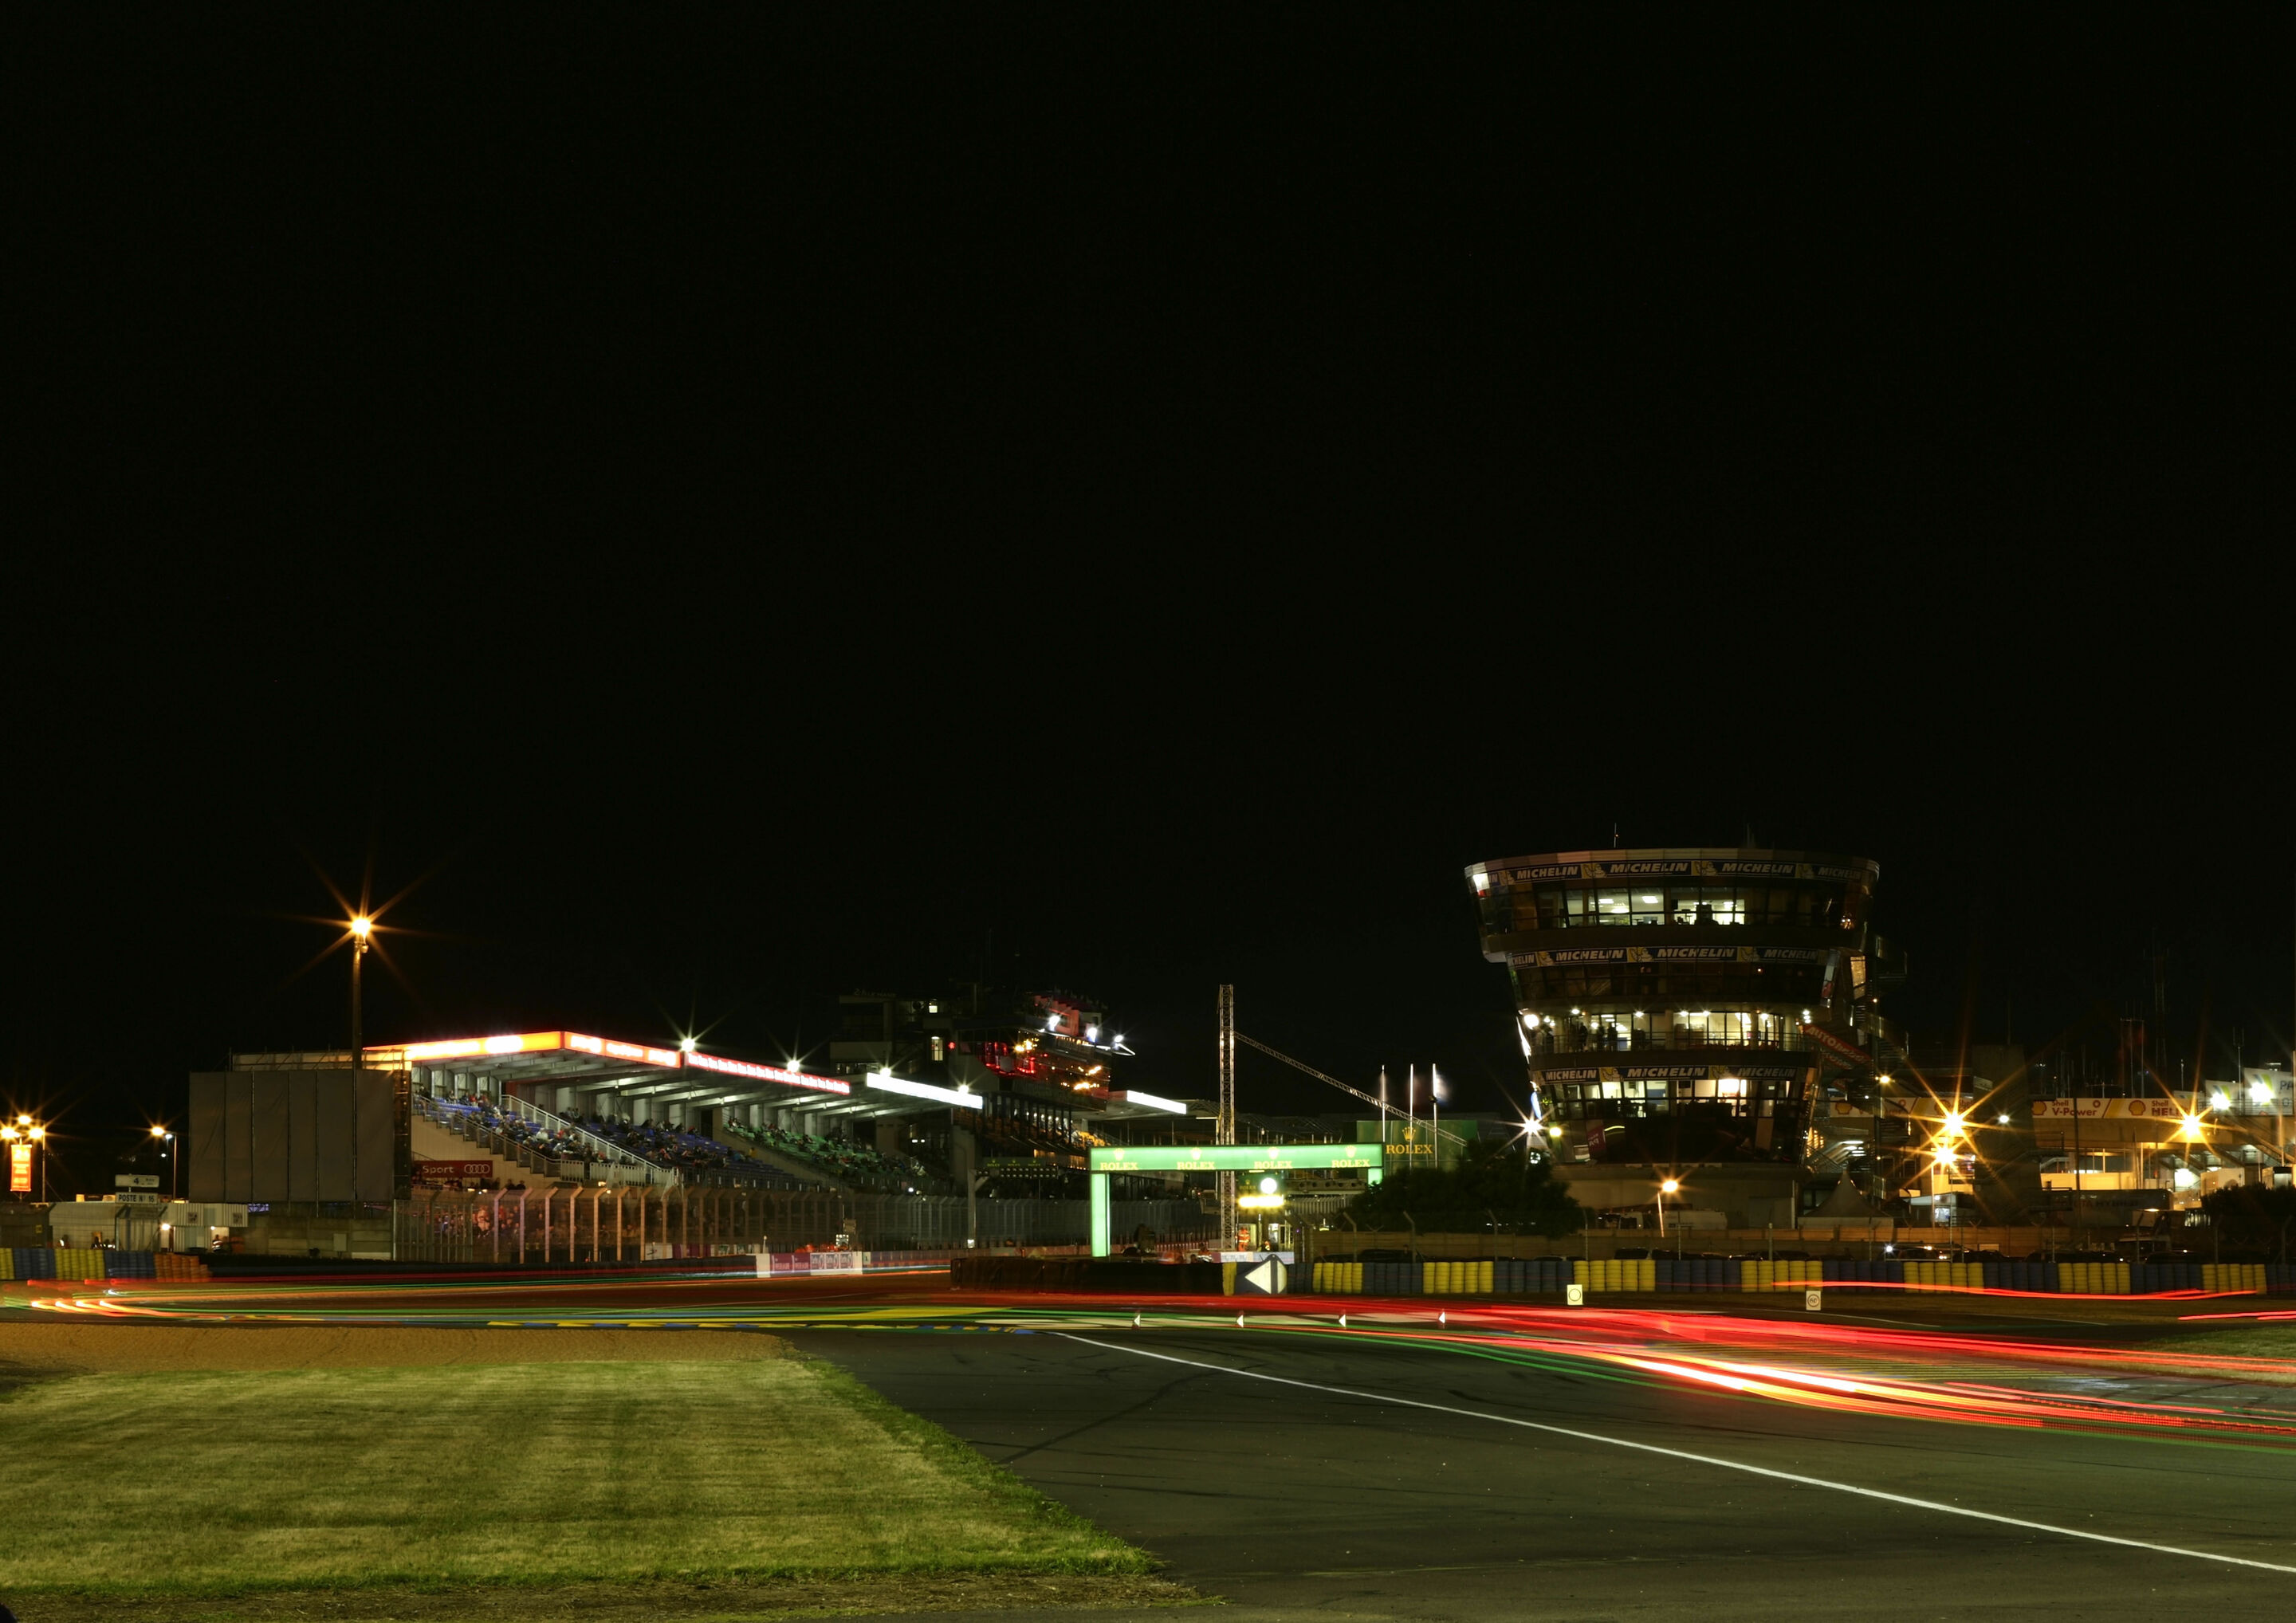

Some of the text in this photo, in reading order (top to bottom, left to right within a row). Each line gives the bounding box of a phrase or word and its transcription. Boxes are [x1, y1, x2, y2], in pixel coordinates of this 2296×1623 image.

[1516, 865, 1578, 880] MICHELIN
[1610, 863, 1689, 874] MICHELIN
[1721, 863, 1795, 874] MICHELIN
[1555, 949, 1624, 961] MICHELIN
[1657, 948, 1735, 957] MICHELIN
[1545, 1069, 1598, 1082] MICHELIN
[1626, 1066, 1708, 1078] MICHELIN
[2052, 1107, 2097, 1116] V-Power
[1386, 1145, 1433, 1154] ROLEX
[1100, 1161, 1139, 1171] ROLEX
[1177, 1161, 1216, 1170] ROLEX
[1254, 1161, 1293, 1169] ROLEX
[1331, 1159, 1370, 1168] ROLEX
[422, 1165, 454, 1174] Sport
